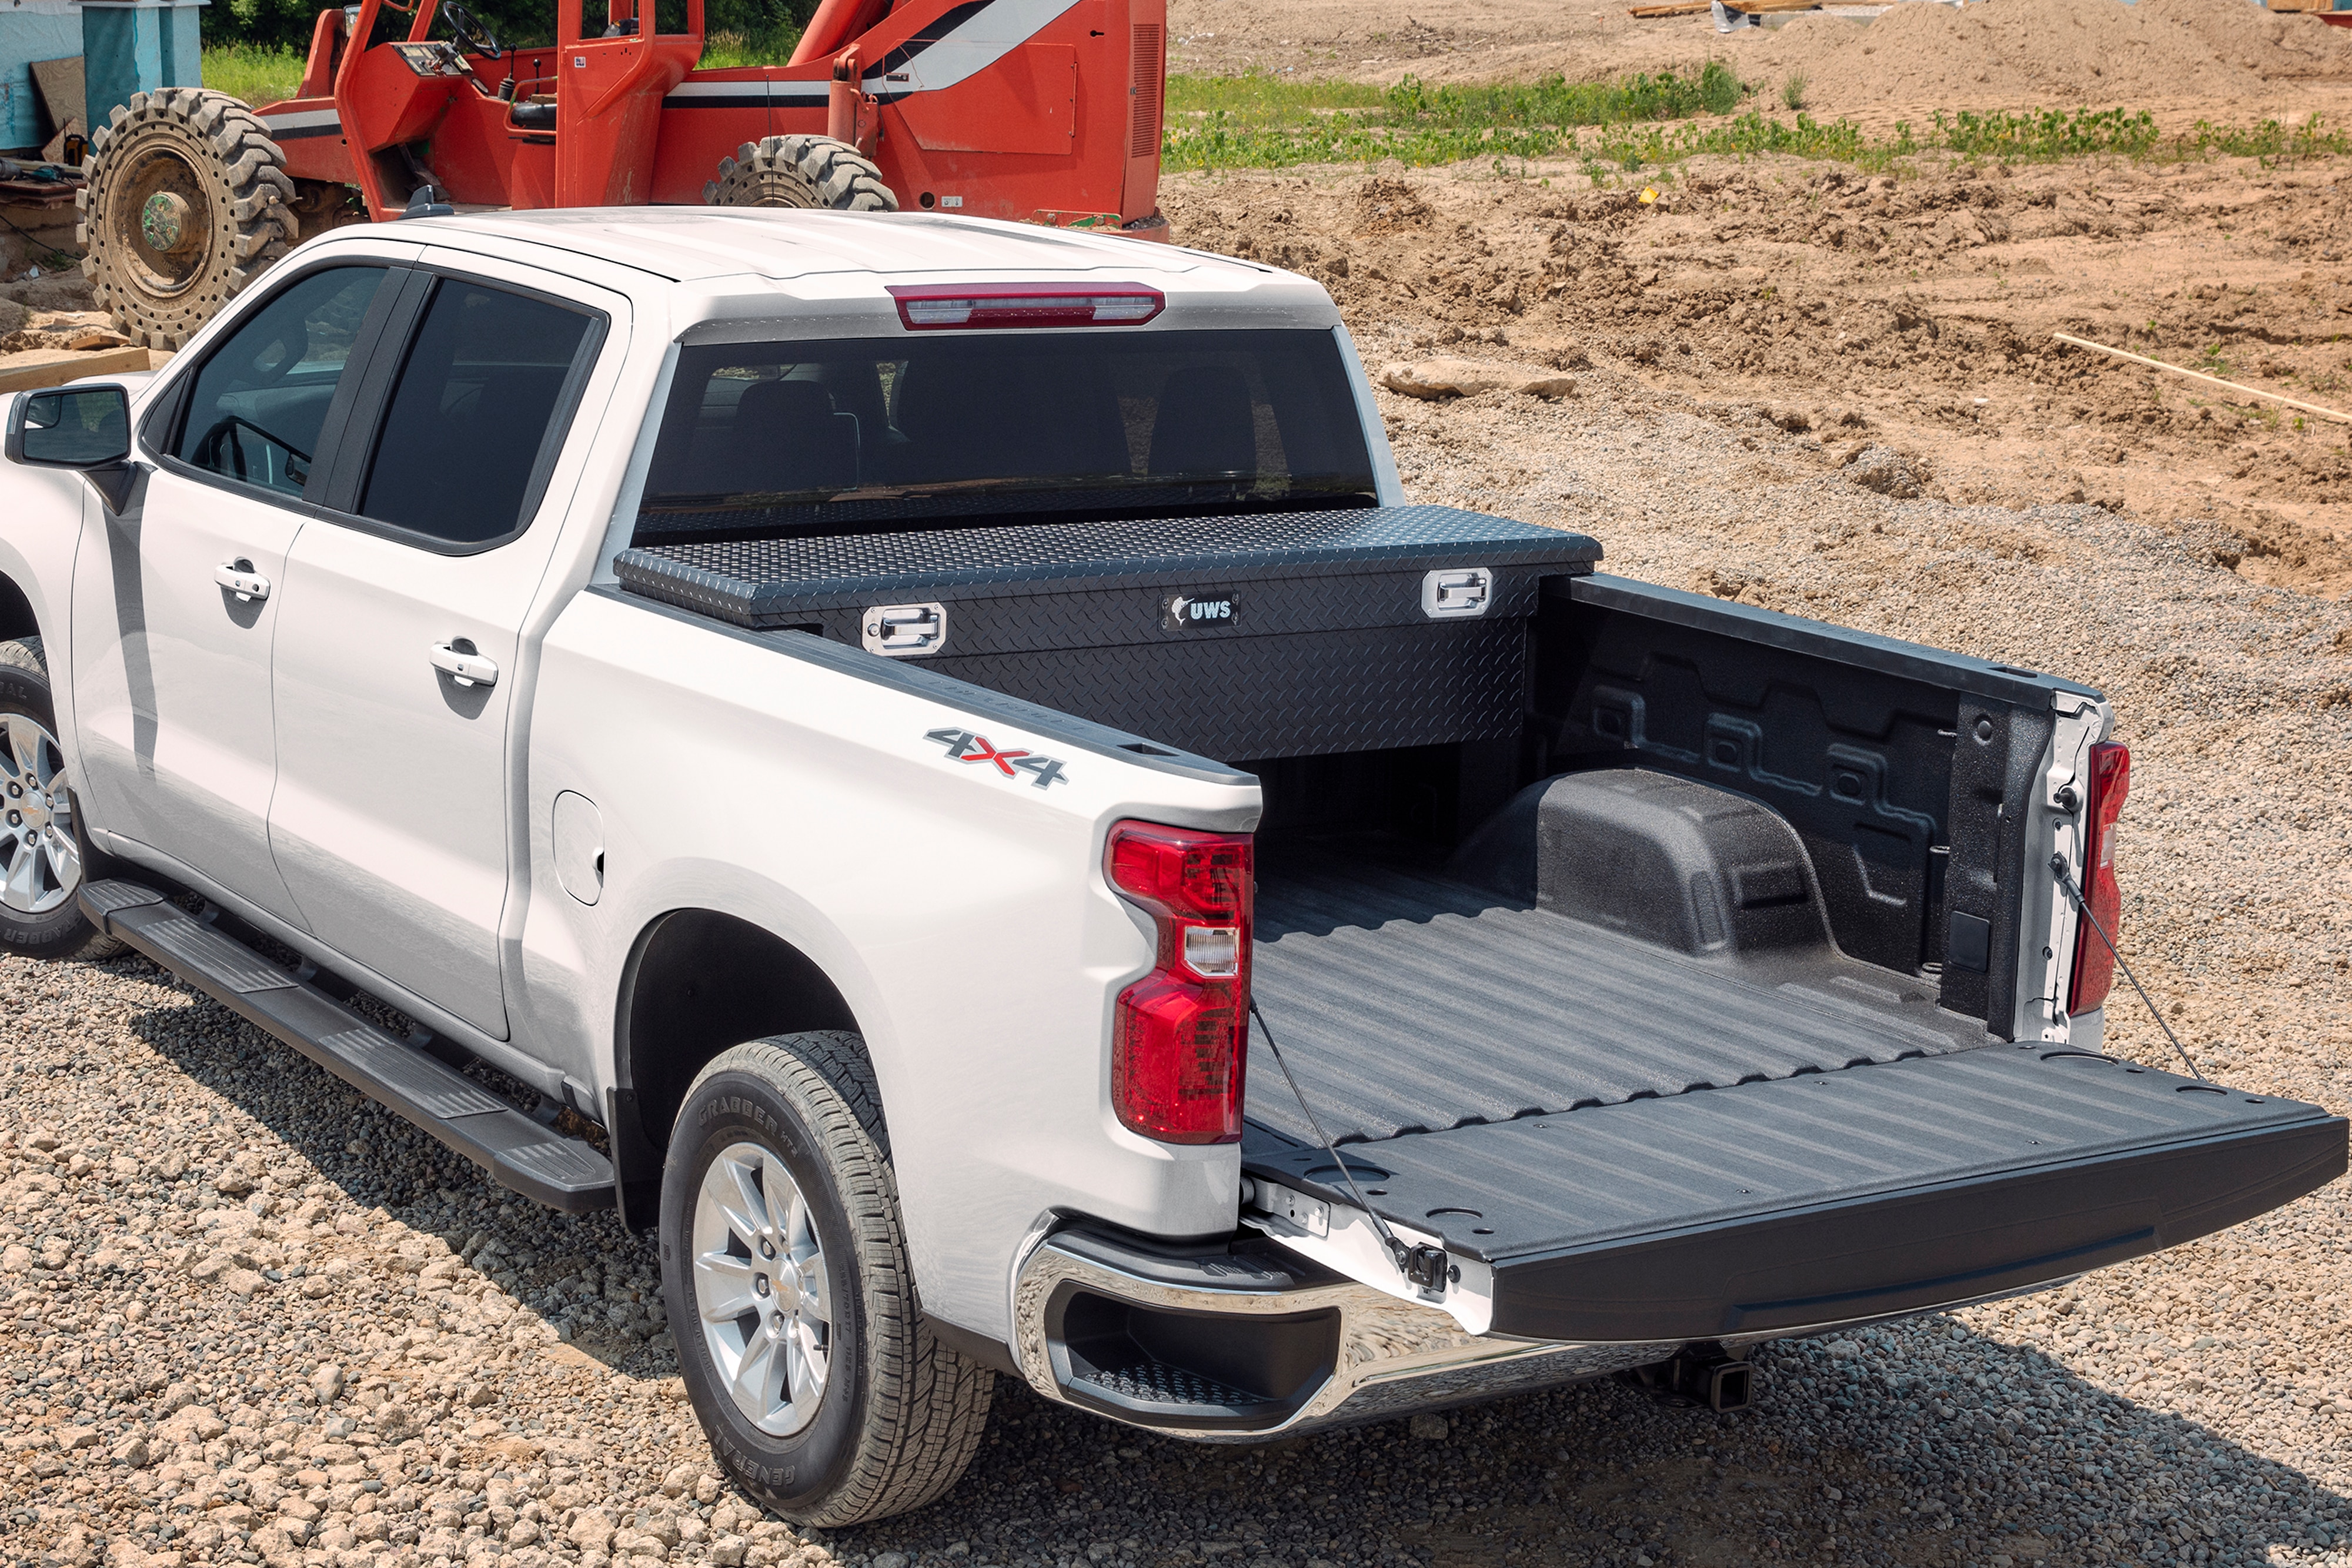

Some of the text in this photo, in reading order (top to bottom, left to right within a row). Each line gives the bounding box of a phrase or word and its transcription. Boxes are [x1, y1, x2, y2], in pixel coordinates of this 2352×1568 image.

[1190, 600, 1231, 620] UWS
[923, 727, 1070, 790] 4X4
[698, 1097, 778, 1137] GRABBER
[714, 1424, 796, 1486] GENERAL
